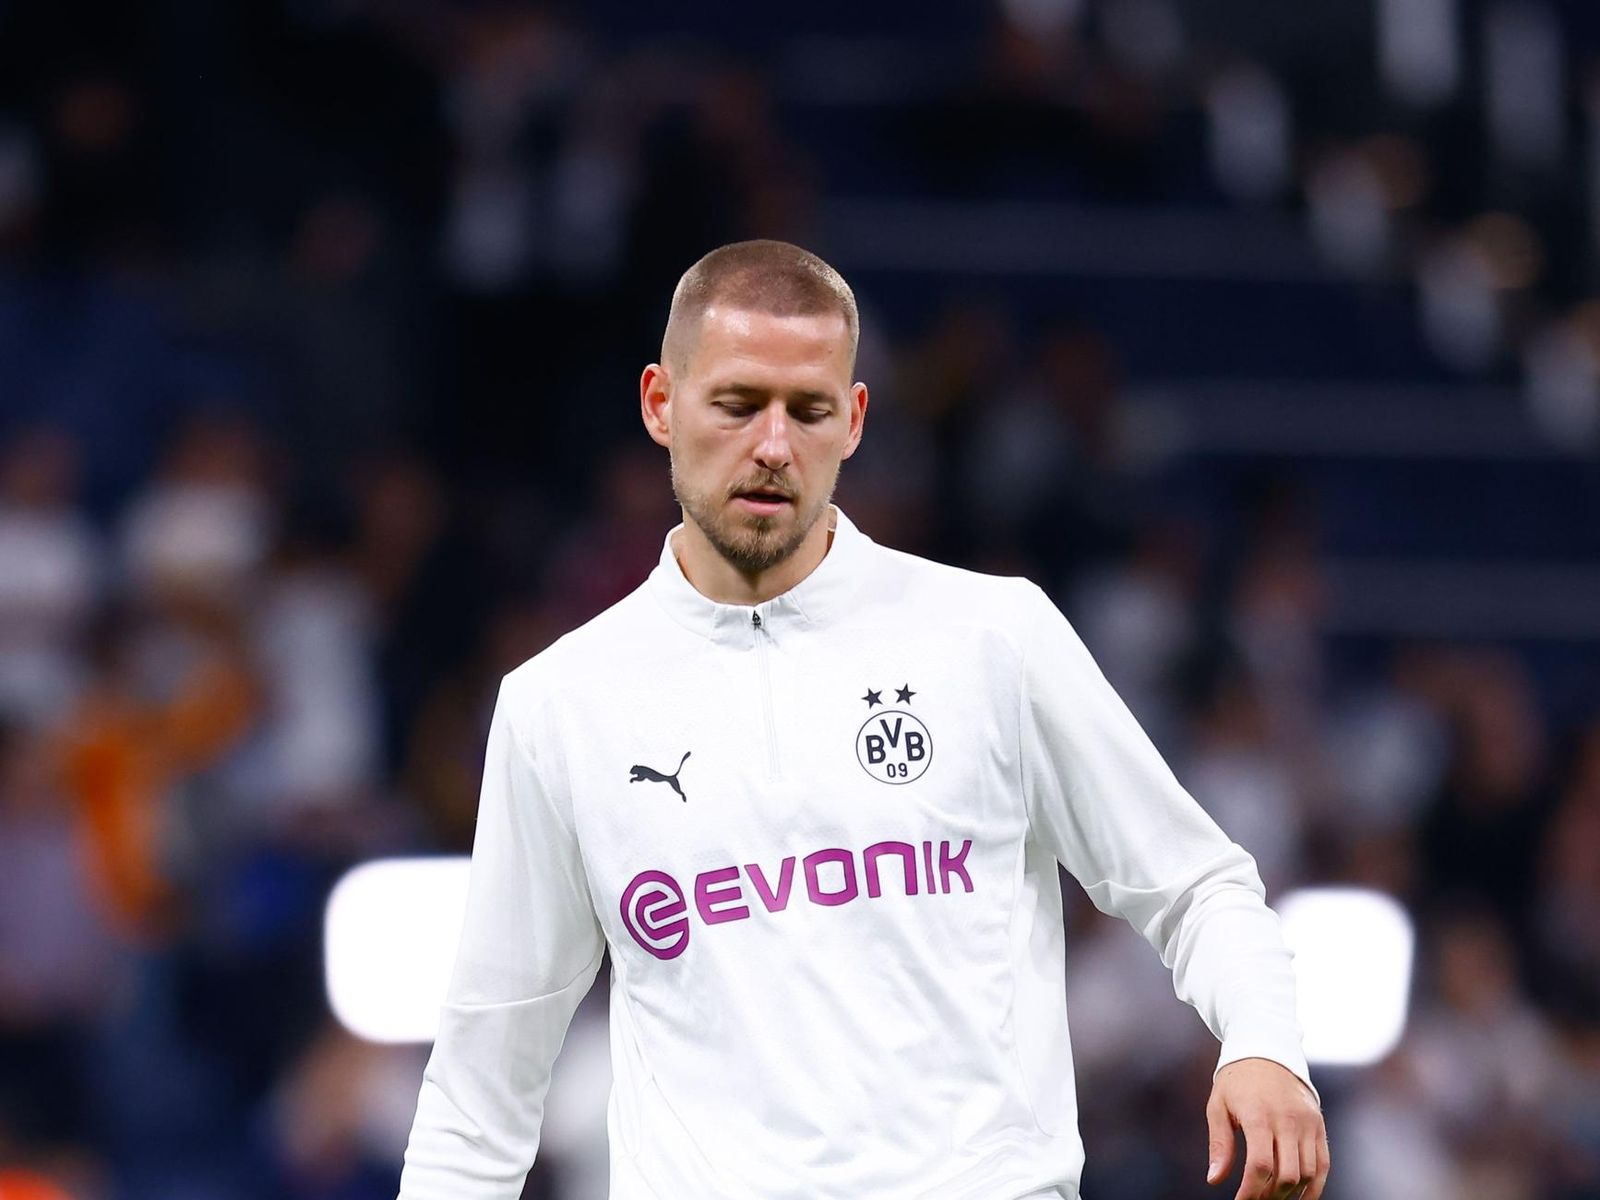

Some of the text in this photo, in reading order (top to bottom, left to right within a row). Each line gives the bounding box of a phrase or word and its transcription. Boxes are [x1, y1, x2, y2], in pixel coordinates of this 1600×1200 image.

[865, 717, 926, 764] BVB
[886, 762, 909, 779] 09
[694, 839, 974, 926] EVONIK
